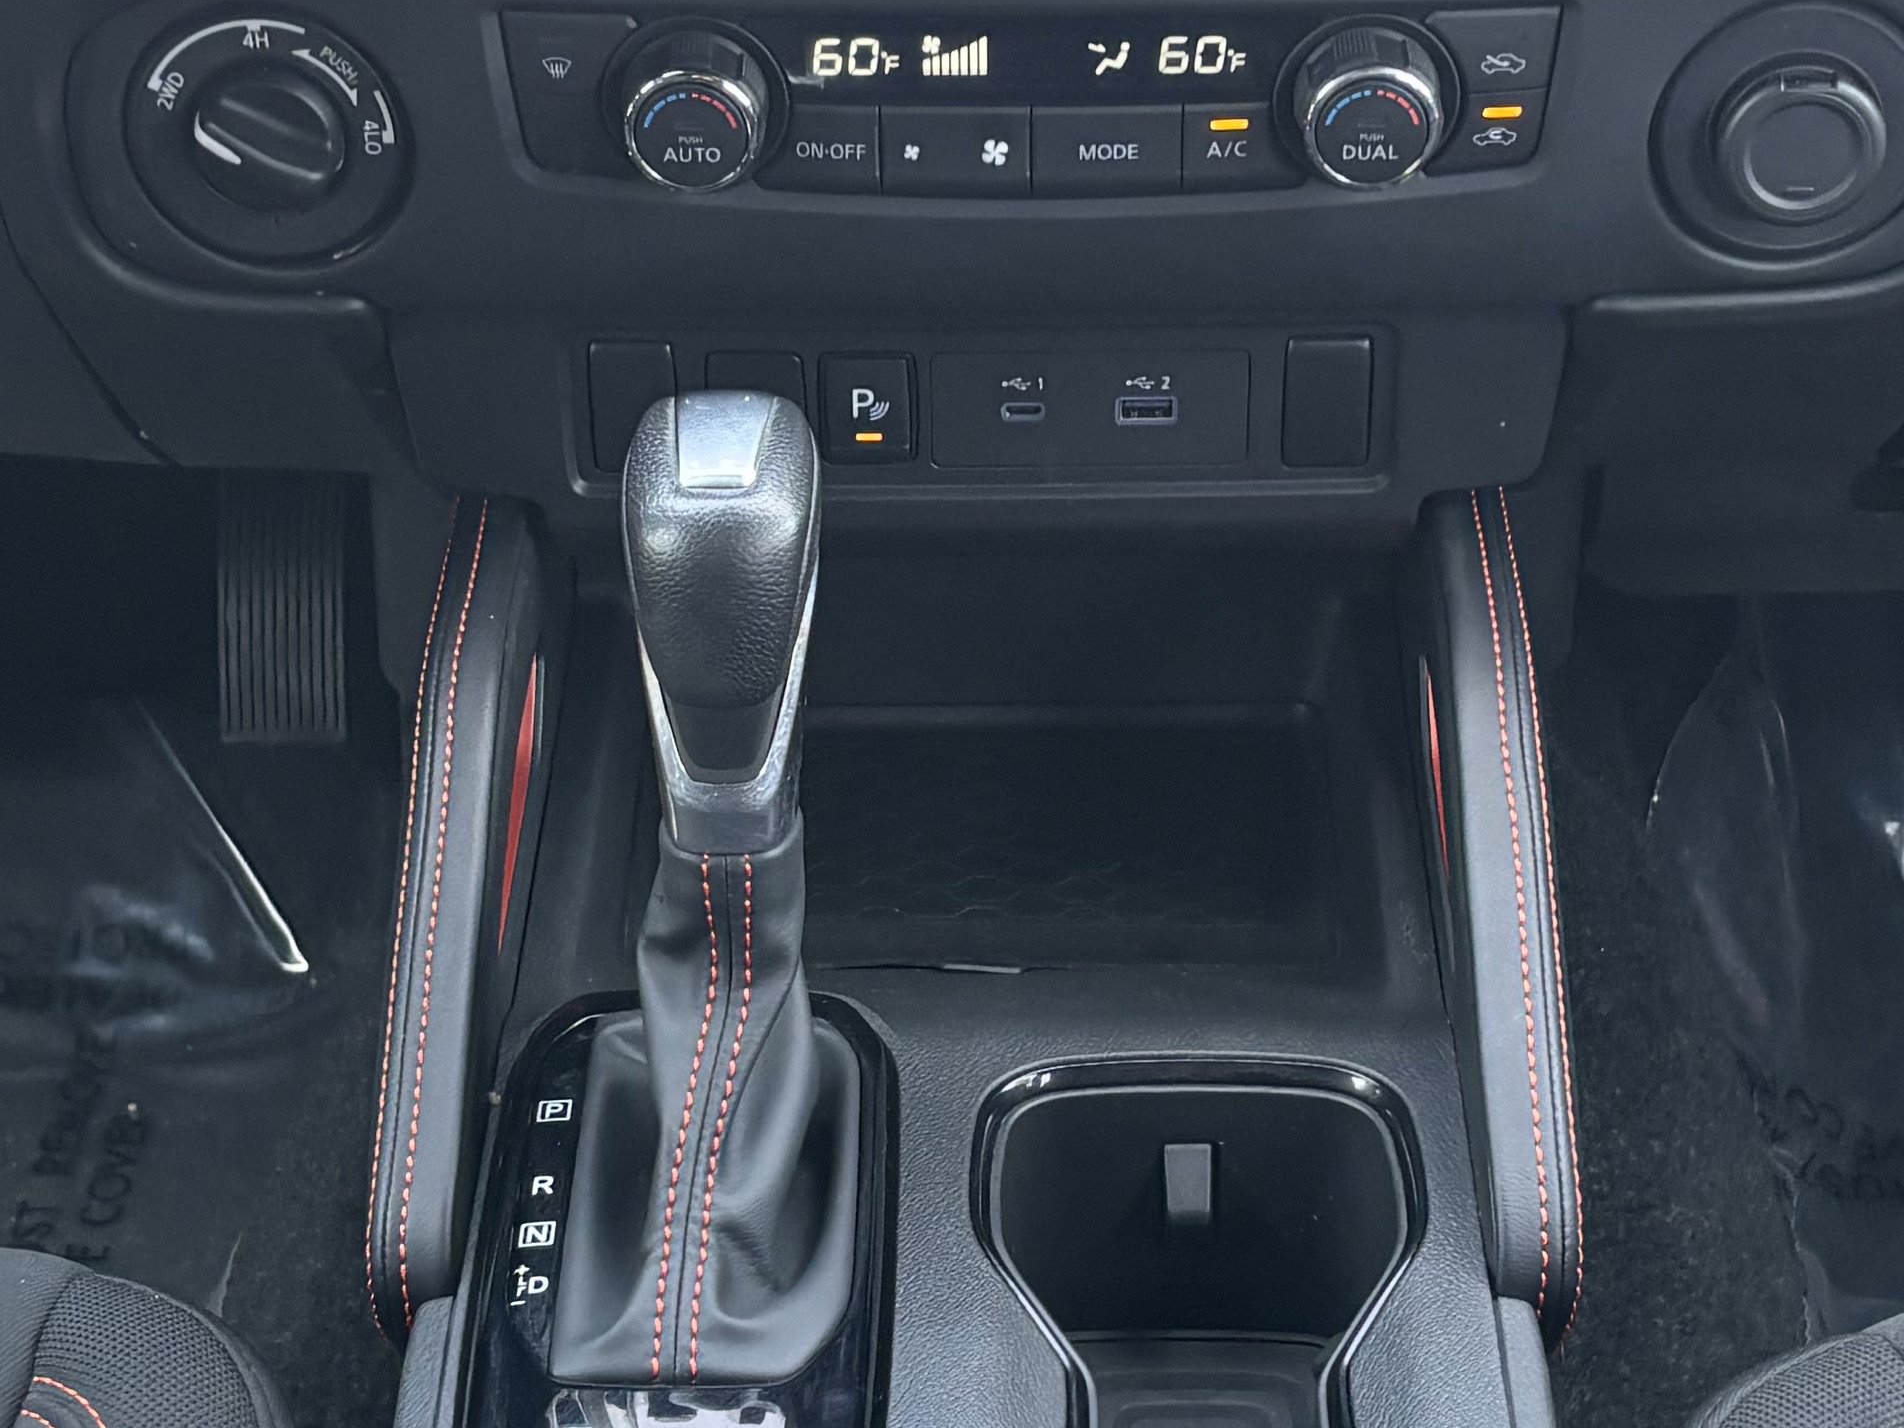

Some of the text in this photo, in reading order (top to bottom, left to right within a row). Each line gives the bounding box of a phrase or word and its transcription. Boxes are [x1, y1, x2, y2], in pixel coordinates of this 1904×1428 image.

[242, 31, 270, 49] 4H
[320, 47, 358, 82] PUSH
[156, 70, 184, 111] 2WD
[362, 119, 382, 155] 4LO
[679, 136, 704, 147] PUSH
[1359, 133, 1383, 144] PUSH
[663, 146, 721, 165] AUTO
[1078, 143, 1139, 162] MODE
[1206, 139, 1247, 161] A/C
[1342, 144, 1399, 163] DUAL
[545, 1103, 564, 1117] P
[531, 1176, 553, 1194] R
[526, 1226, 547, 1242] N
[528, 1276, 549, 1294] D
